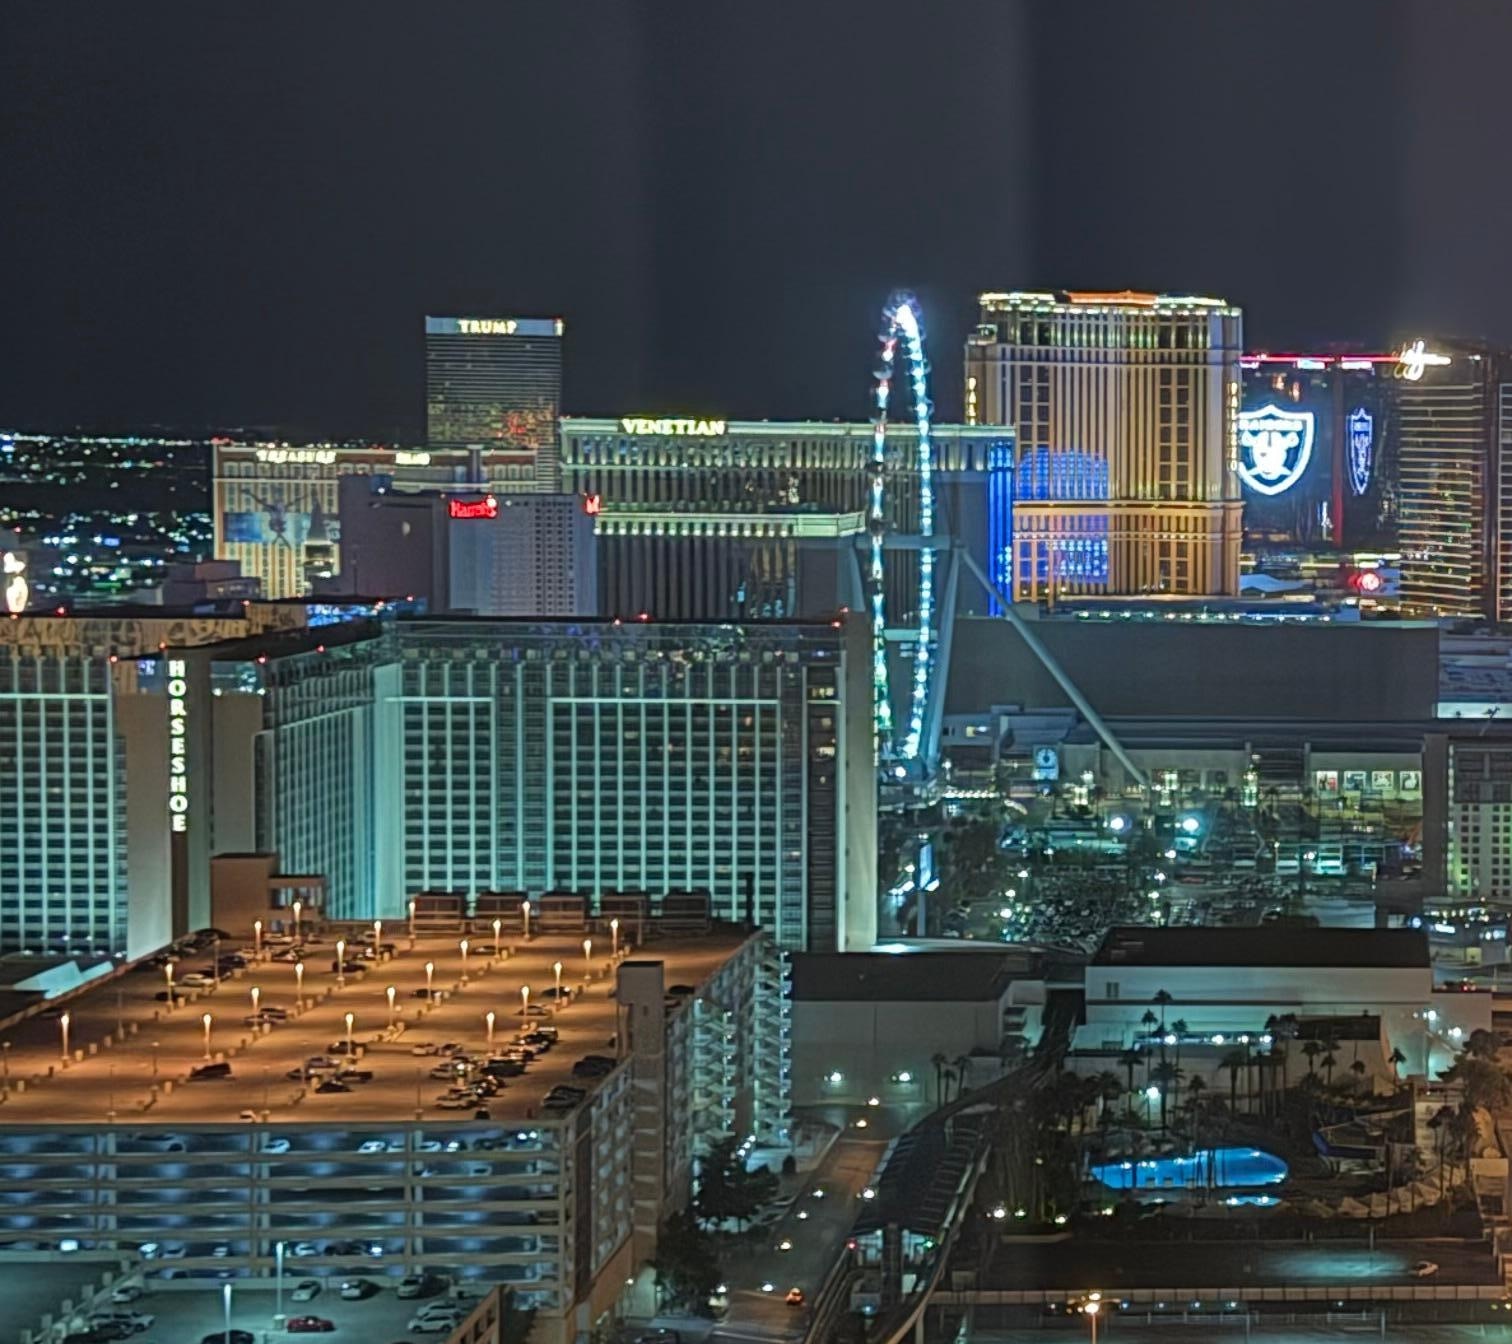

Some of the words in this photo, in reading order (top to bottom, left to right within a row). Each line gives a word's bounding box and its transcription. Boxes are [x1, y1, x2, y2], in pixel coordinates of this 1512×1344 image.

[457, 318, 517, 334] TRUMP
[622, 419, 725, 435] VENETIAN
[167, 659, 188, 832] HORSESHOE
